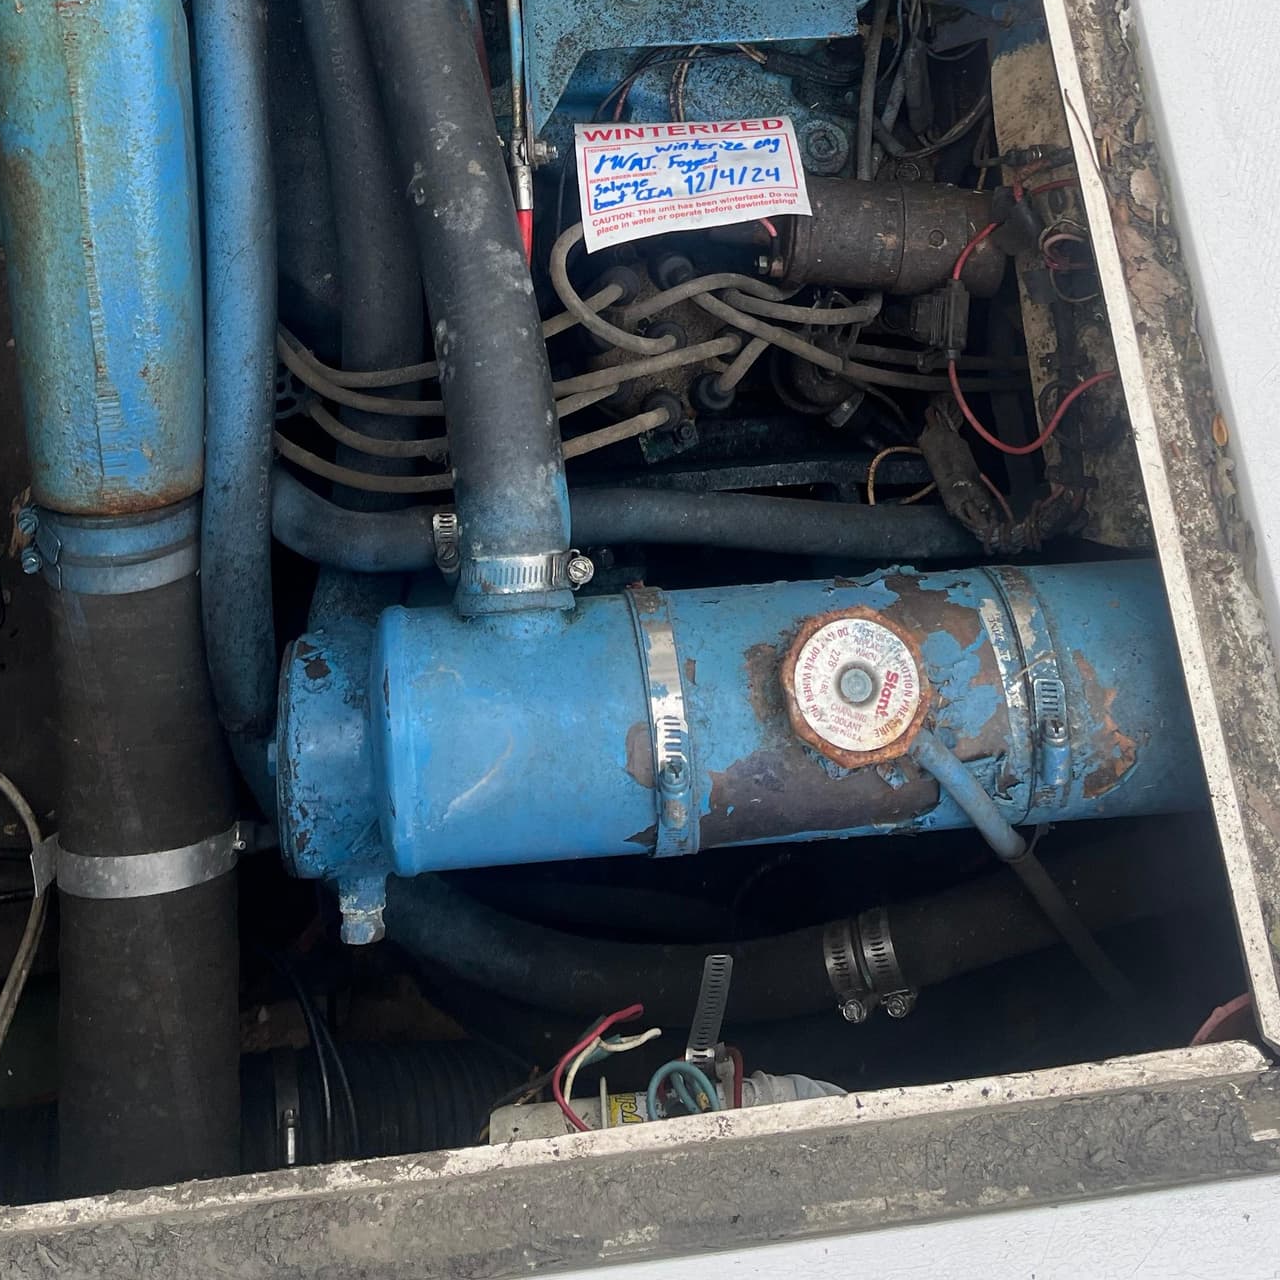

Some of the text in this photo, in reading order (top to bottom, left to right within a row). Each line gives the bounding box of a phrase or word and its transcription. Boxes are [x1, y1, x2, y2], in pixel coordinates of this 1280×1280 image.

[583, 119, 784, 142] WINTERIZED
[655, 138, 780, 154] winterize eng
[667, 151, 718, 175] Fogged
[684, 166, 781, 196] 12/4/24
[592, 210, 634, 227] CAUTION:
[638, 207, 657, 217] This
[658, 205, 676, 215] unit
[677, 202, 694, 210] has
[695, 200, 718, 209] been
[719, 193, 767, 203] winterized.
[596, 223, 620, 236] place
[621, 221, 630, 229] in
[631, 216, 656, 226] water
[668, 209, 703, 220] operate
[704, 204, 733, 215] before
[803, 646, 821, 671] OPEN
[802, 672, 815, 702] WHEN
[875, 669, 899, 717] Stant
